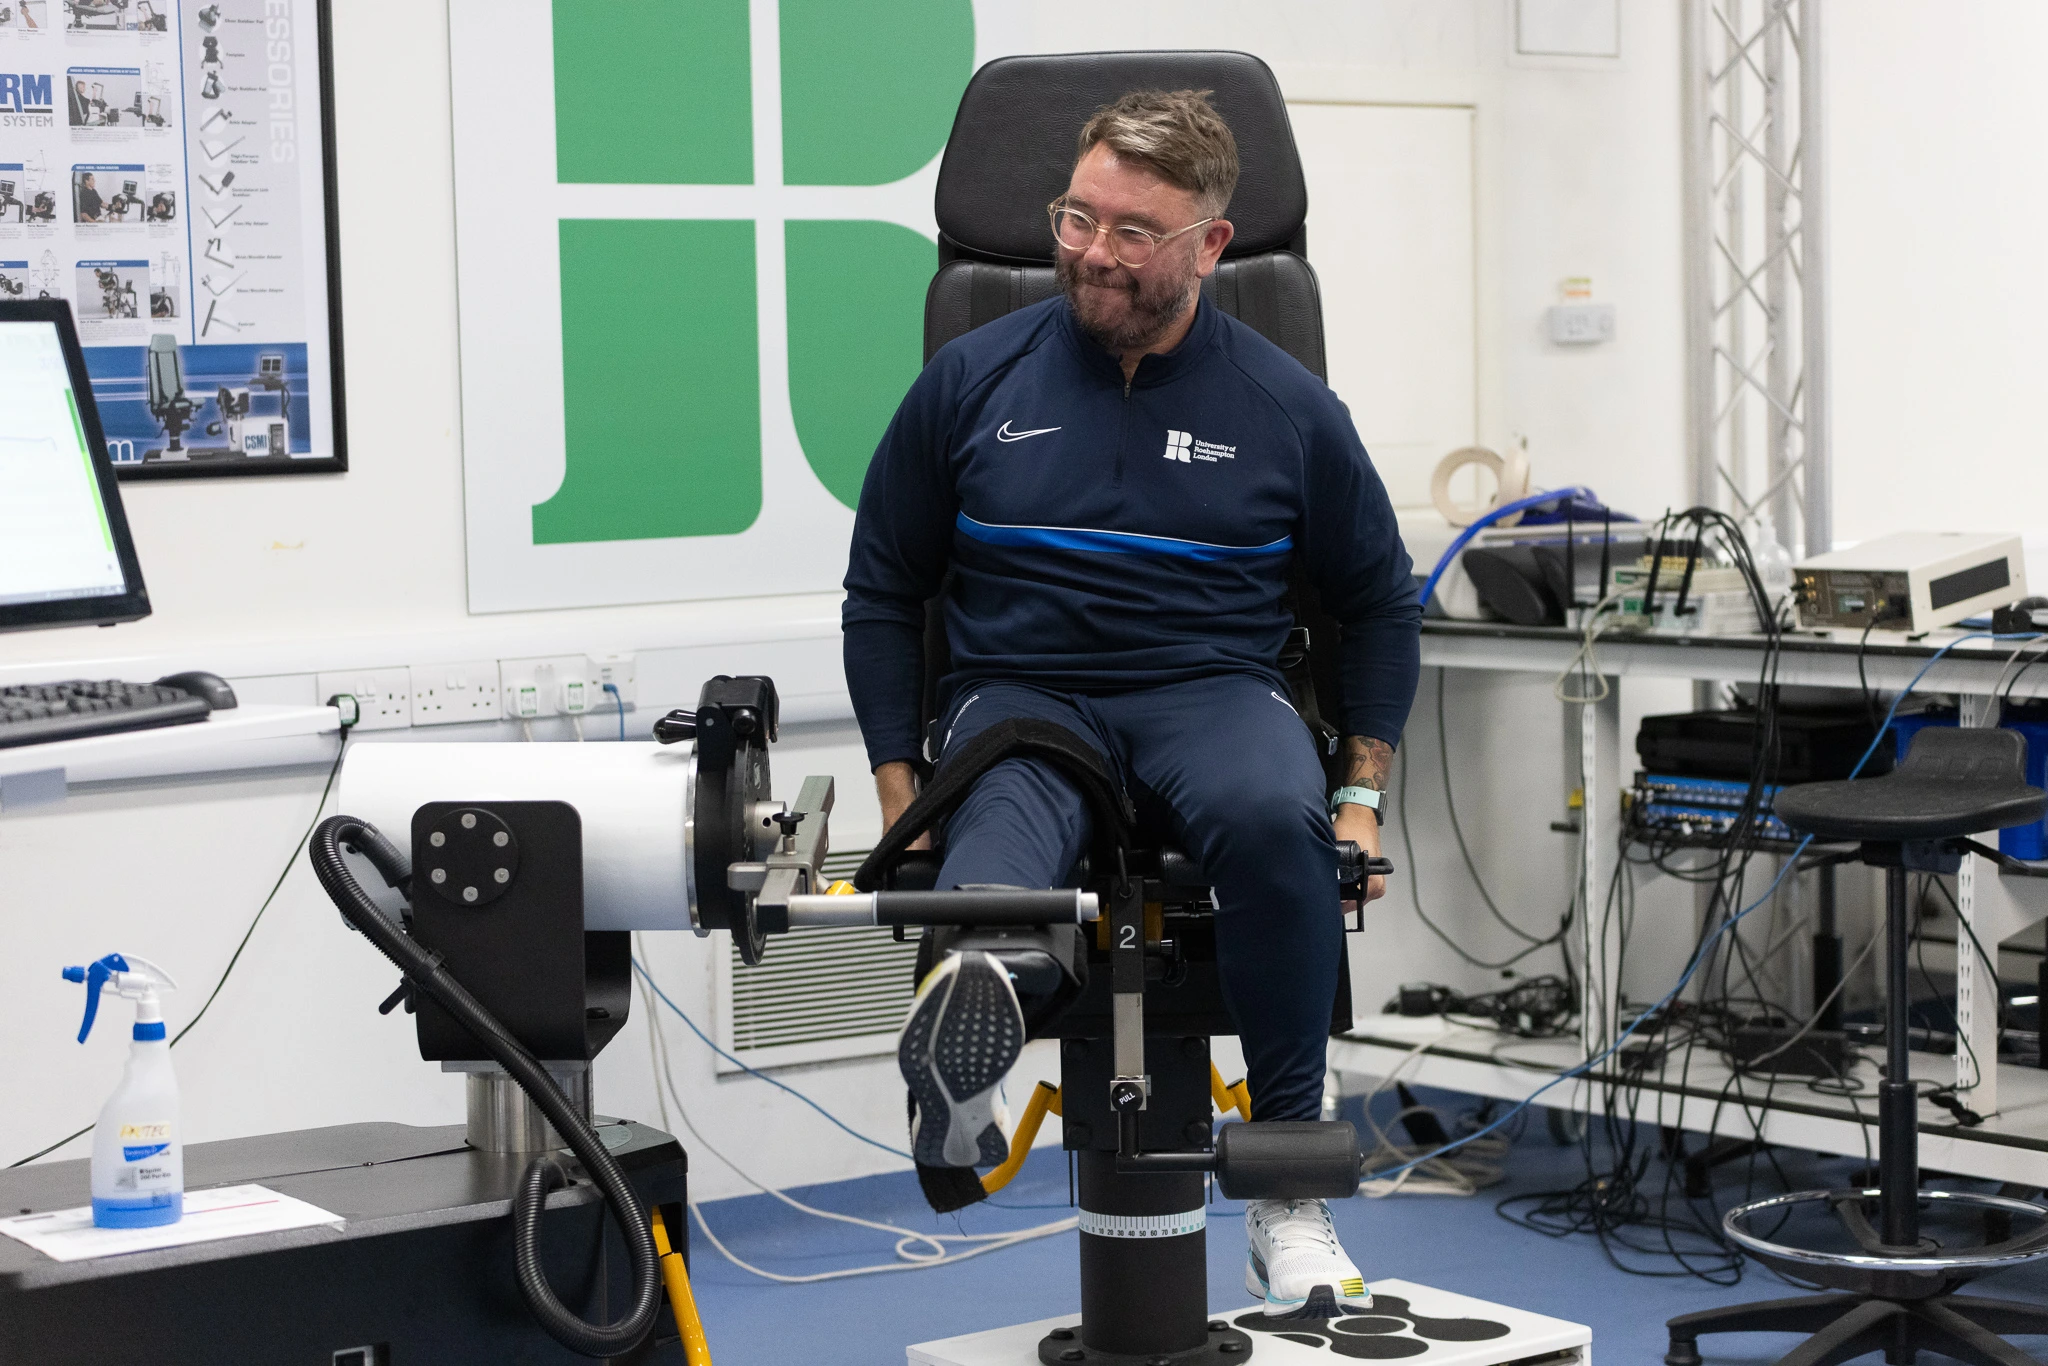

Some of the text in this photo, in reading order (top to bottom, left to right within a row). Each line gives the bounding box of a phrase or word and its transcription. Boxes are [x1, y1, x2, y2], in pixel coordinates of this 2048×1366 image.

[3, 115, 54, 127] SYSTEM
[1194, 446, 1235, 459] Roehampton
[1195, 440, 1237, 453] University of
[1193, 453, 1218, 462] London
[1118, 925, 1136, 949] 2
[1118, 1092, 1136, 1105] PULL
